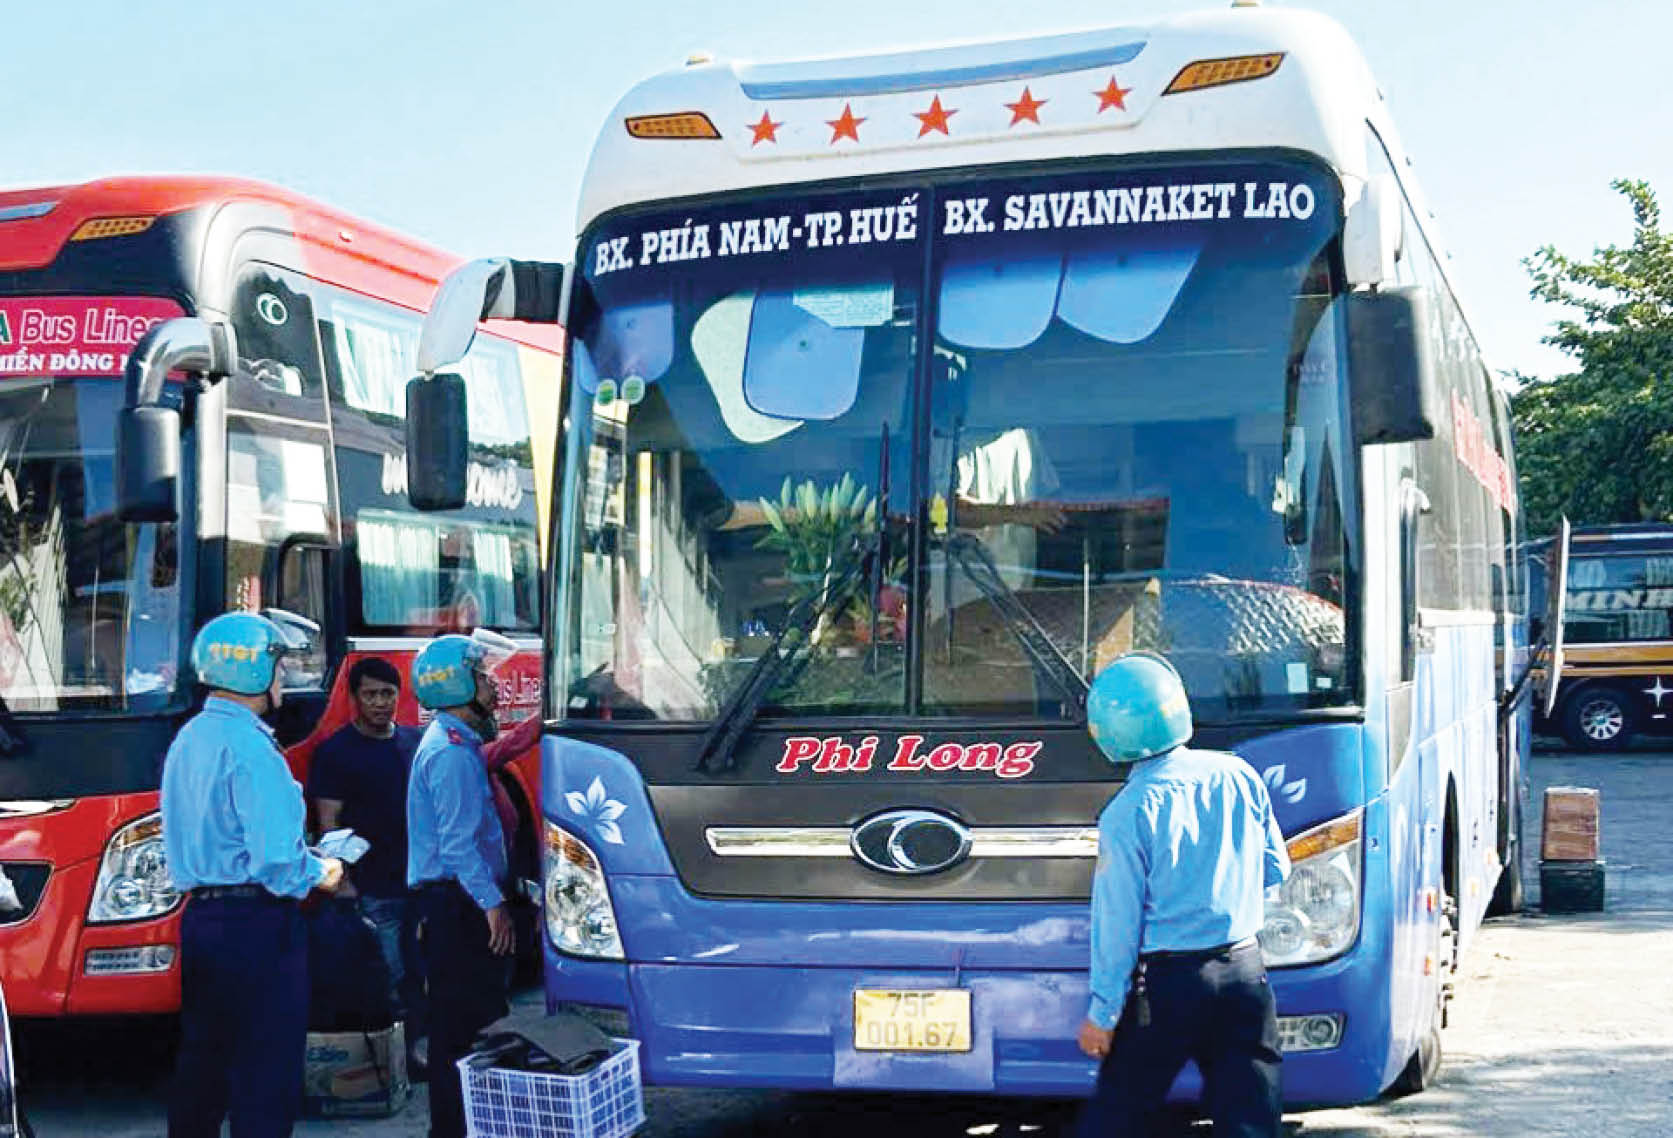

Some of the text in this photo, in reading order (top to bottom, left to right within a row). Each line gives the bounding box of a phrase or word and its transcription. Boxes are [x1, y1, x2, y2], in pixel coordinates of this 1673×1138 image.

[943, 182, 1315, 234] BX. SAVANNAKET LAO
[594, 236, 634, 276] BX.
[640, 218, 712, 266] PHÍA
[20, 309, 76, 344] Bus
[49, 348, 114, 371] ĐÔNG
[776, 735, 1043, 778] Phi Long
[887, 992, 936, 1017] 75F
[867, 1021, 958, 1047] 001.67
